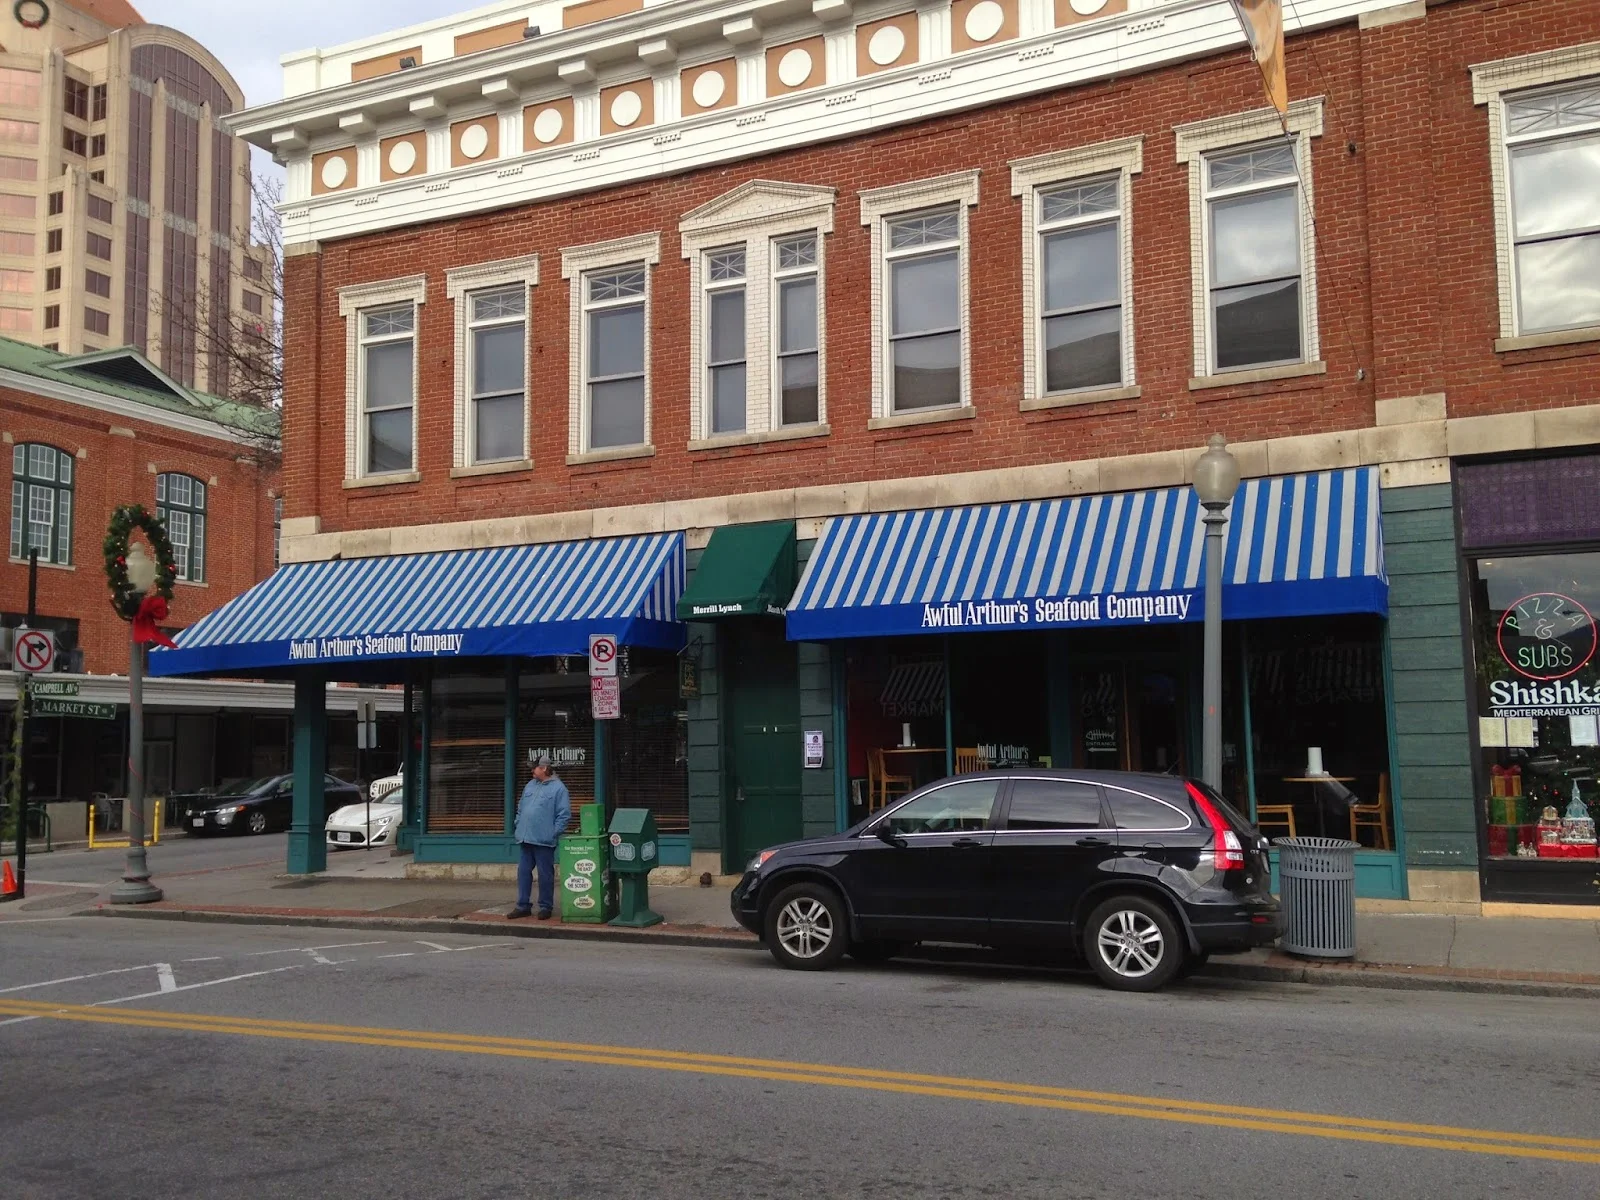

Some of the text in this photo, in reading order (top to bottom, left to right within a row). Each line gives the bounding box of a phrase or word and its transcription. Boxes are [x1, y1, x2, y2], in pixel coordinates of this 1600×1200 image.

[693, 603, 742, 614] Merrill Lynch
[921, 594, 1192, 627] Awful Arthur's Seafood Company
[1505, 598, 1585, 629] PIZZA
[1534, 618, 1556, 640] &
[288, 632, 464, 660] Awful Arthur's Seafood Company
[1518, 645, 1573, 669] SUBS
[34, 683, 74, 694] CAMPBELL AV
[592, 679, 602, 689] NO
[42, 701, 86, 714] MARKET
[87, 704, 100, 715] ST
[1493, 707, 1580, 718] MEDITERRANEAN
[552, 746, 585, 761] Arthur's
[977, 743, 1029, 760] Awful Arthur's
